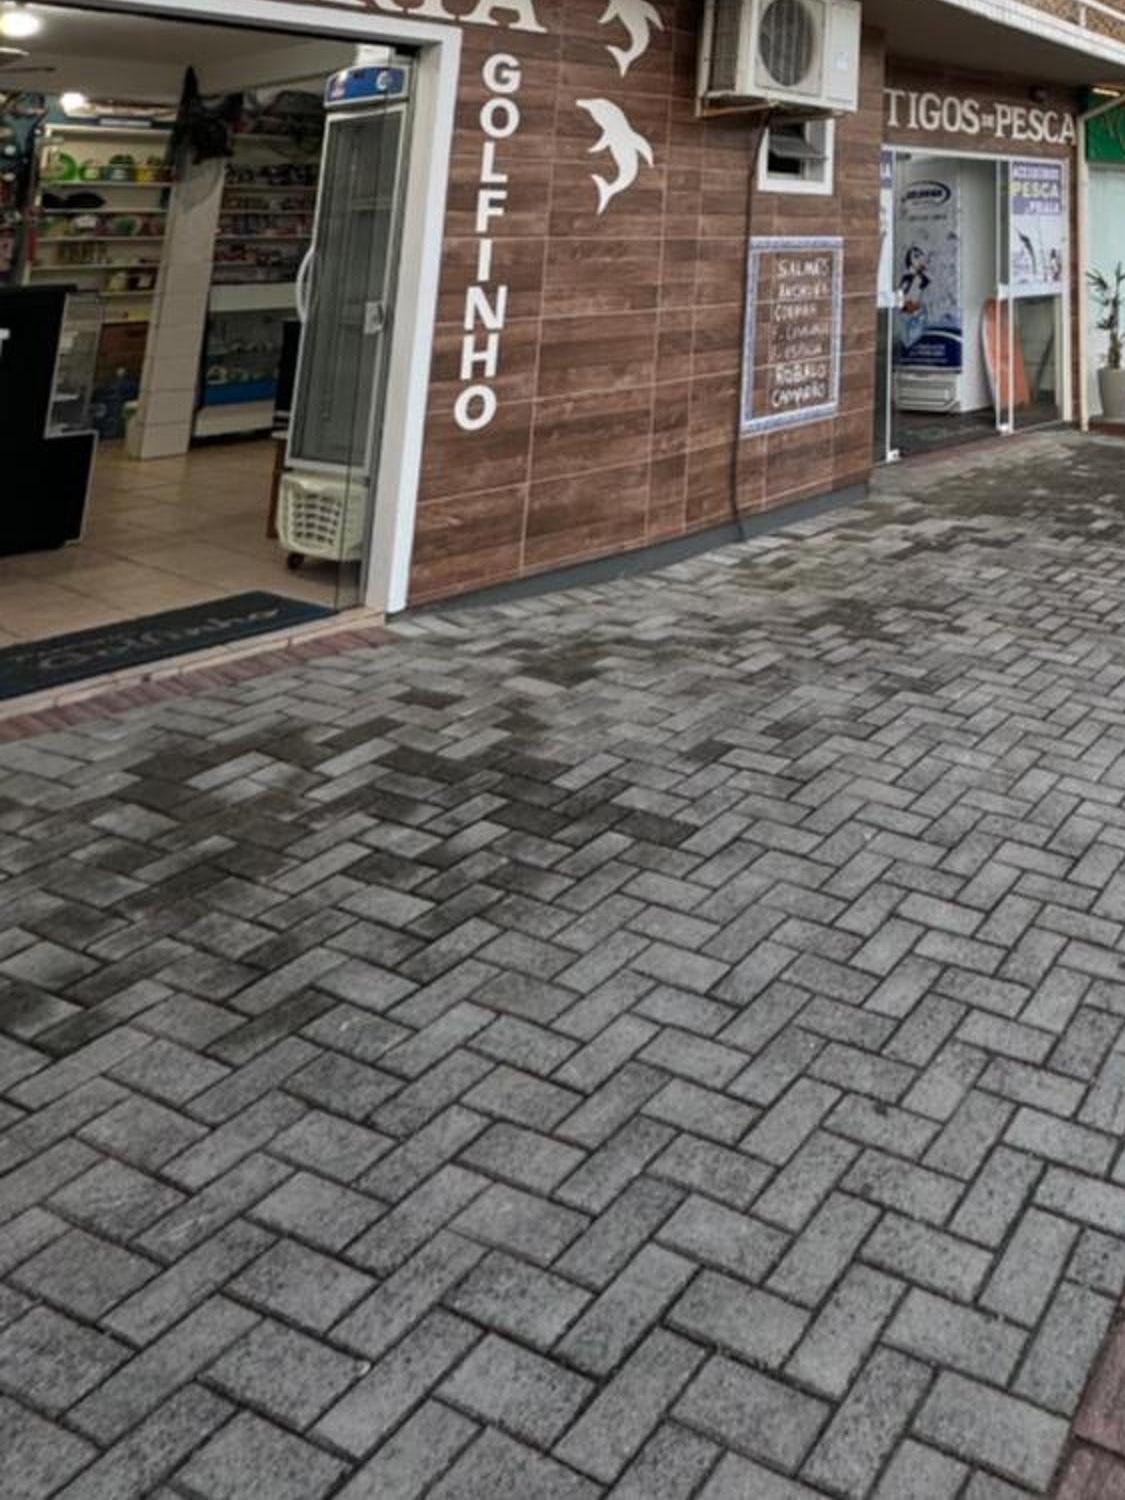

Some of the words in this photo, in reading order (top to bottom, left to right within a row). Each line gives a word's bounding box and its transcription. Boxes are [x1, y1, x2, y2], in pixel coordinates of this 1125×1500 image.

[883, 88, 980, 134] TIGOS
[994, 102, 1076, 145] PESCA
[1009, 181, 1058, 198] PESCA
[454, 53, 521, 431] GOLFINHO
